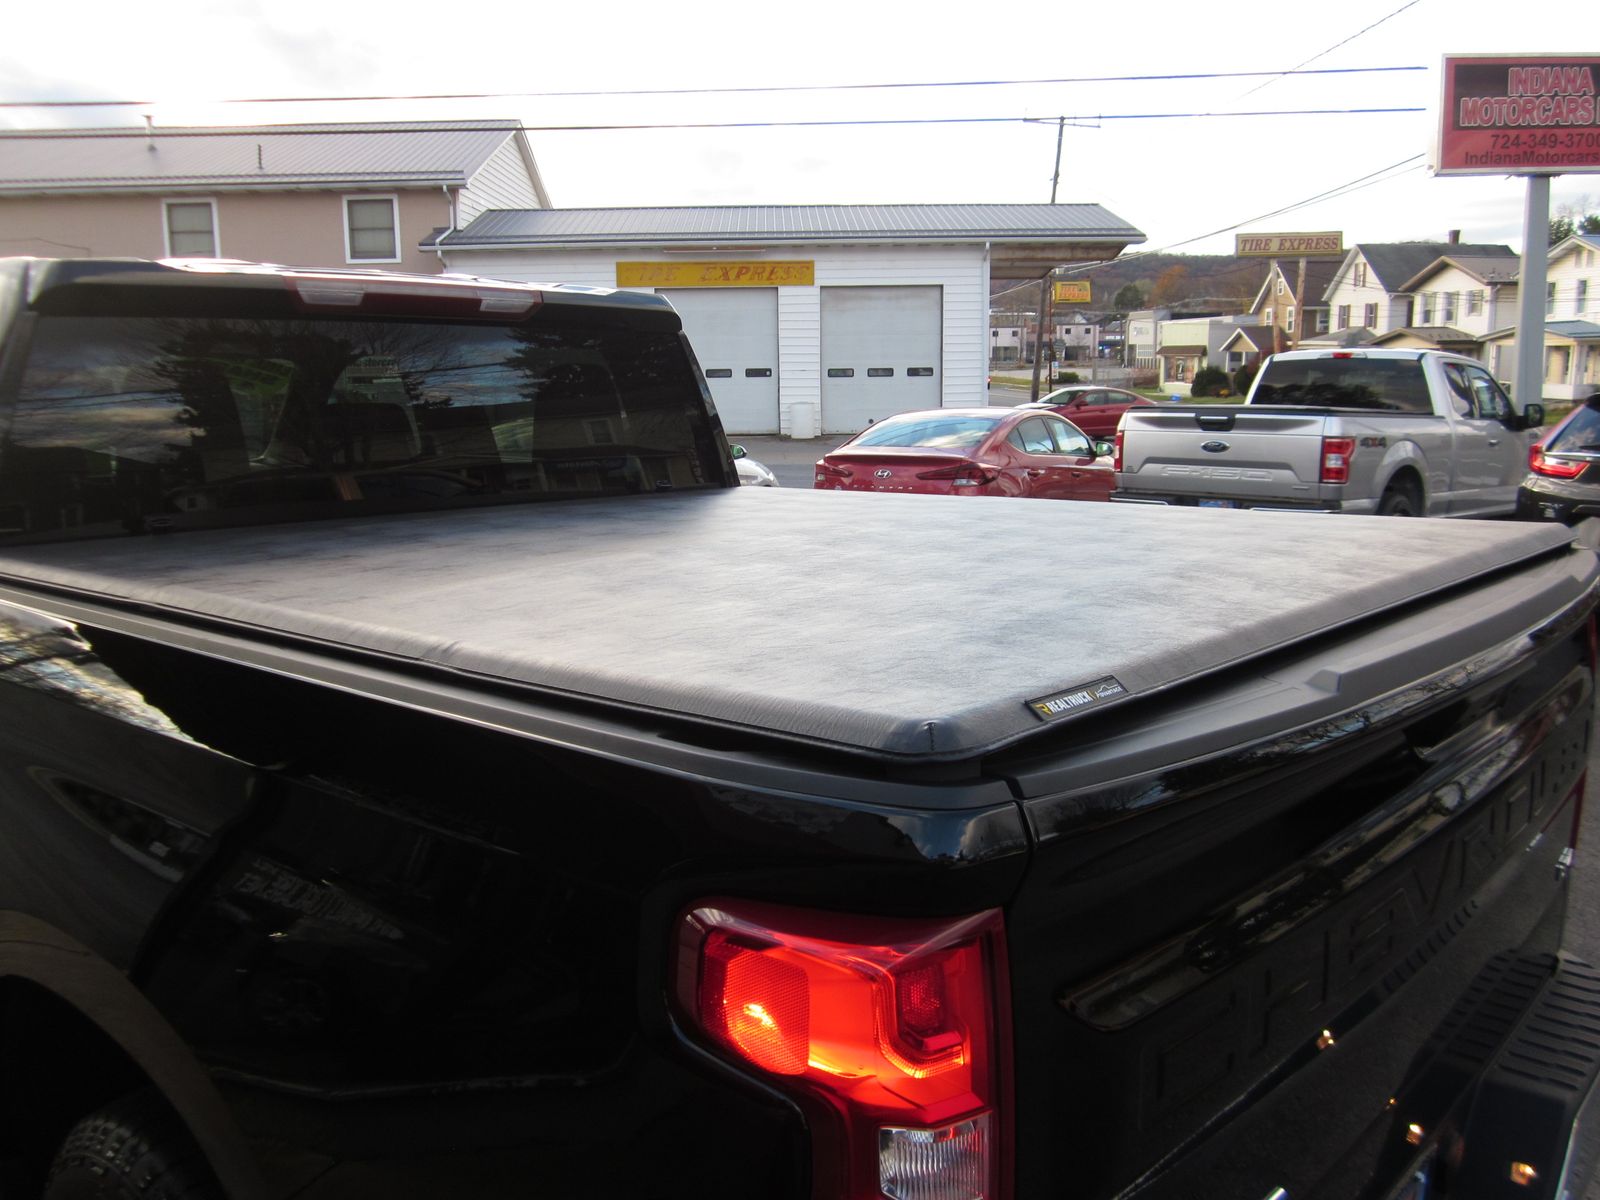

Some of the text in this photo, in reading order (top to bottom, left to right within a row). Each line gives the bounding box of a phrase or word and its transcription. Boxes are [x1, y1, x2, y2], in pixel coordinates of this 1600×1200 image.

[1507, 67, 1595, 96] INDIANA
[1460, 96, 1595, 126] MOTORCARS
[1240, 237, 1339, 252] TIRE EXPRESS
[1045, 691, 1093, 713] REALTRUCK
